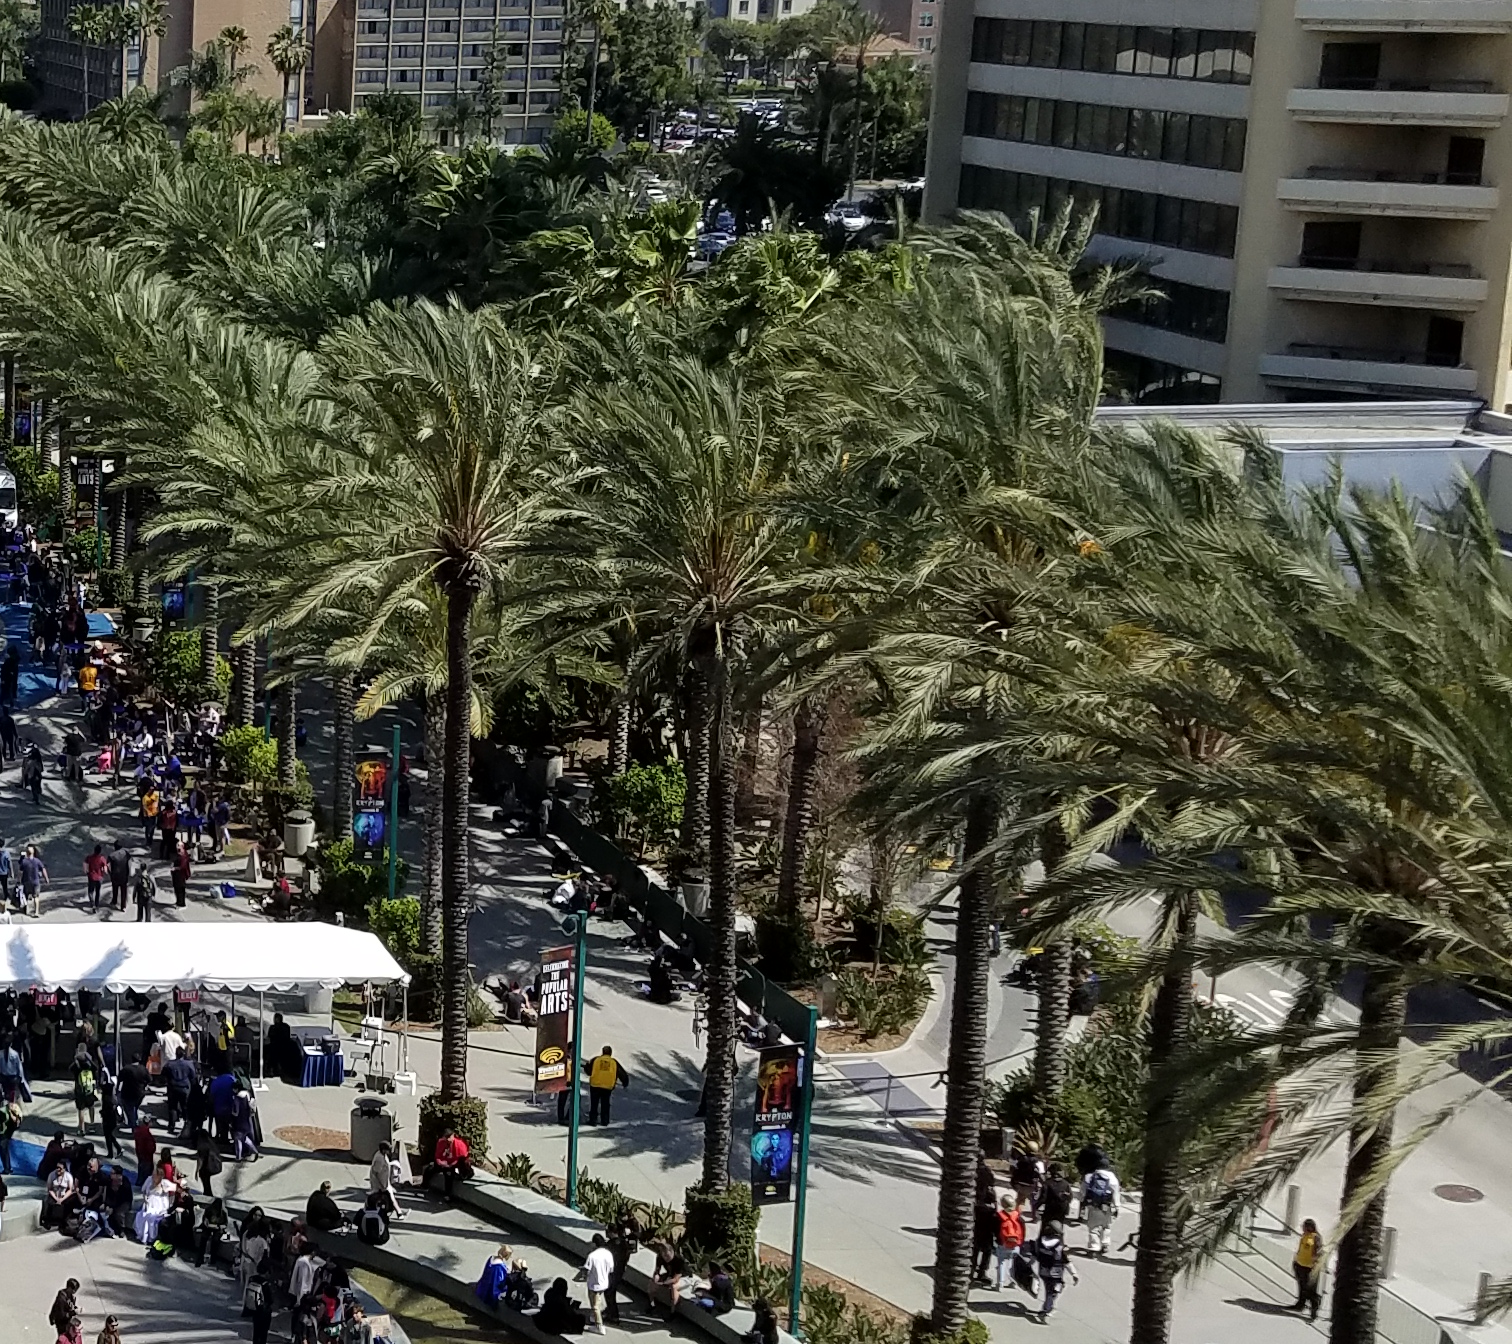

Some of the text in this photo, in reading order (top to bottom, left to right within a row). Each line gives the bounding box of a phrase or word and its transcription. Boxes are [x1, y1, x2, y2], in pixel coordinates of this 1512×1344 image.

[541, 978, 568, 996] POPULAR
[180, 990, 196, 1000] EXIT
[540, 991, 569, 1016] ARTS
[755, 1111, 793, 1123] KRYPTON
